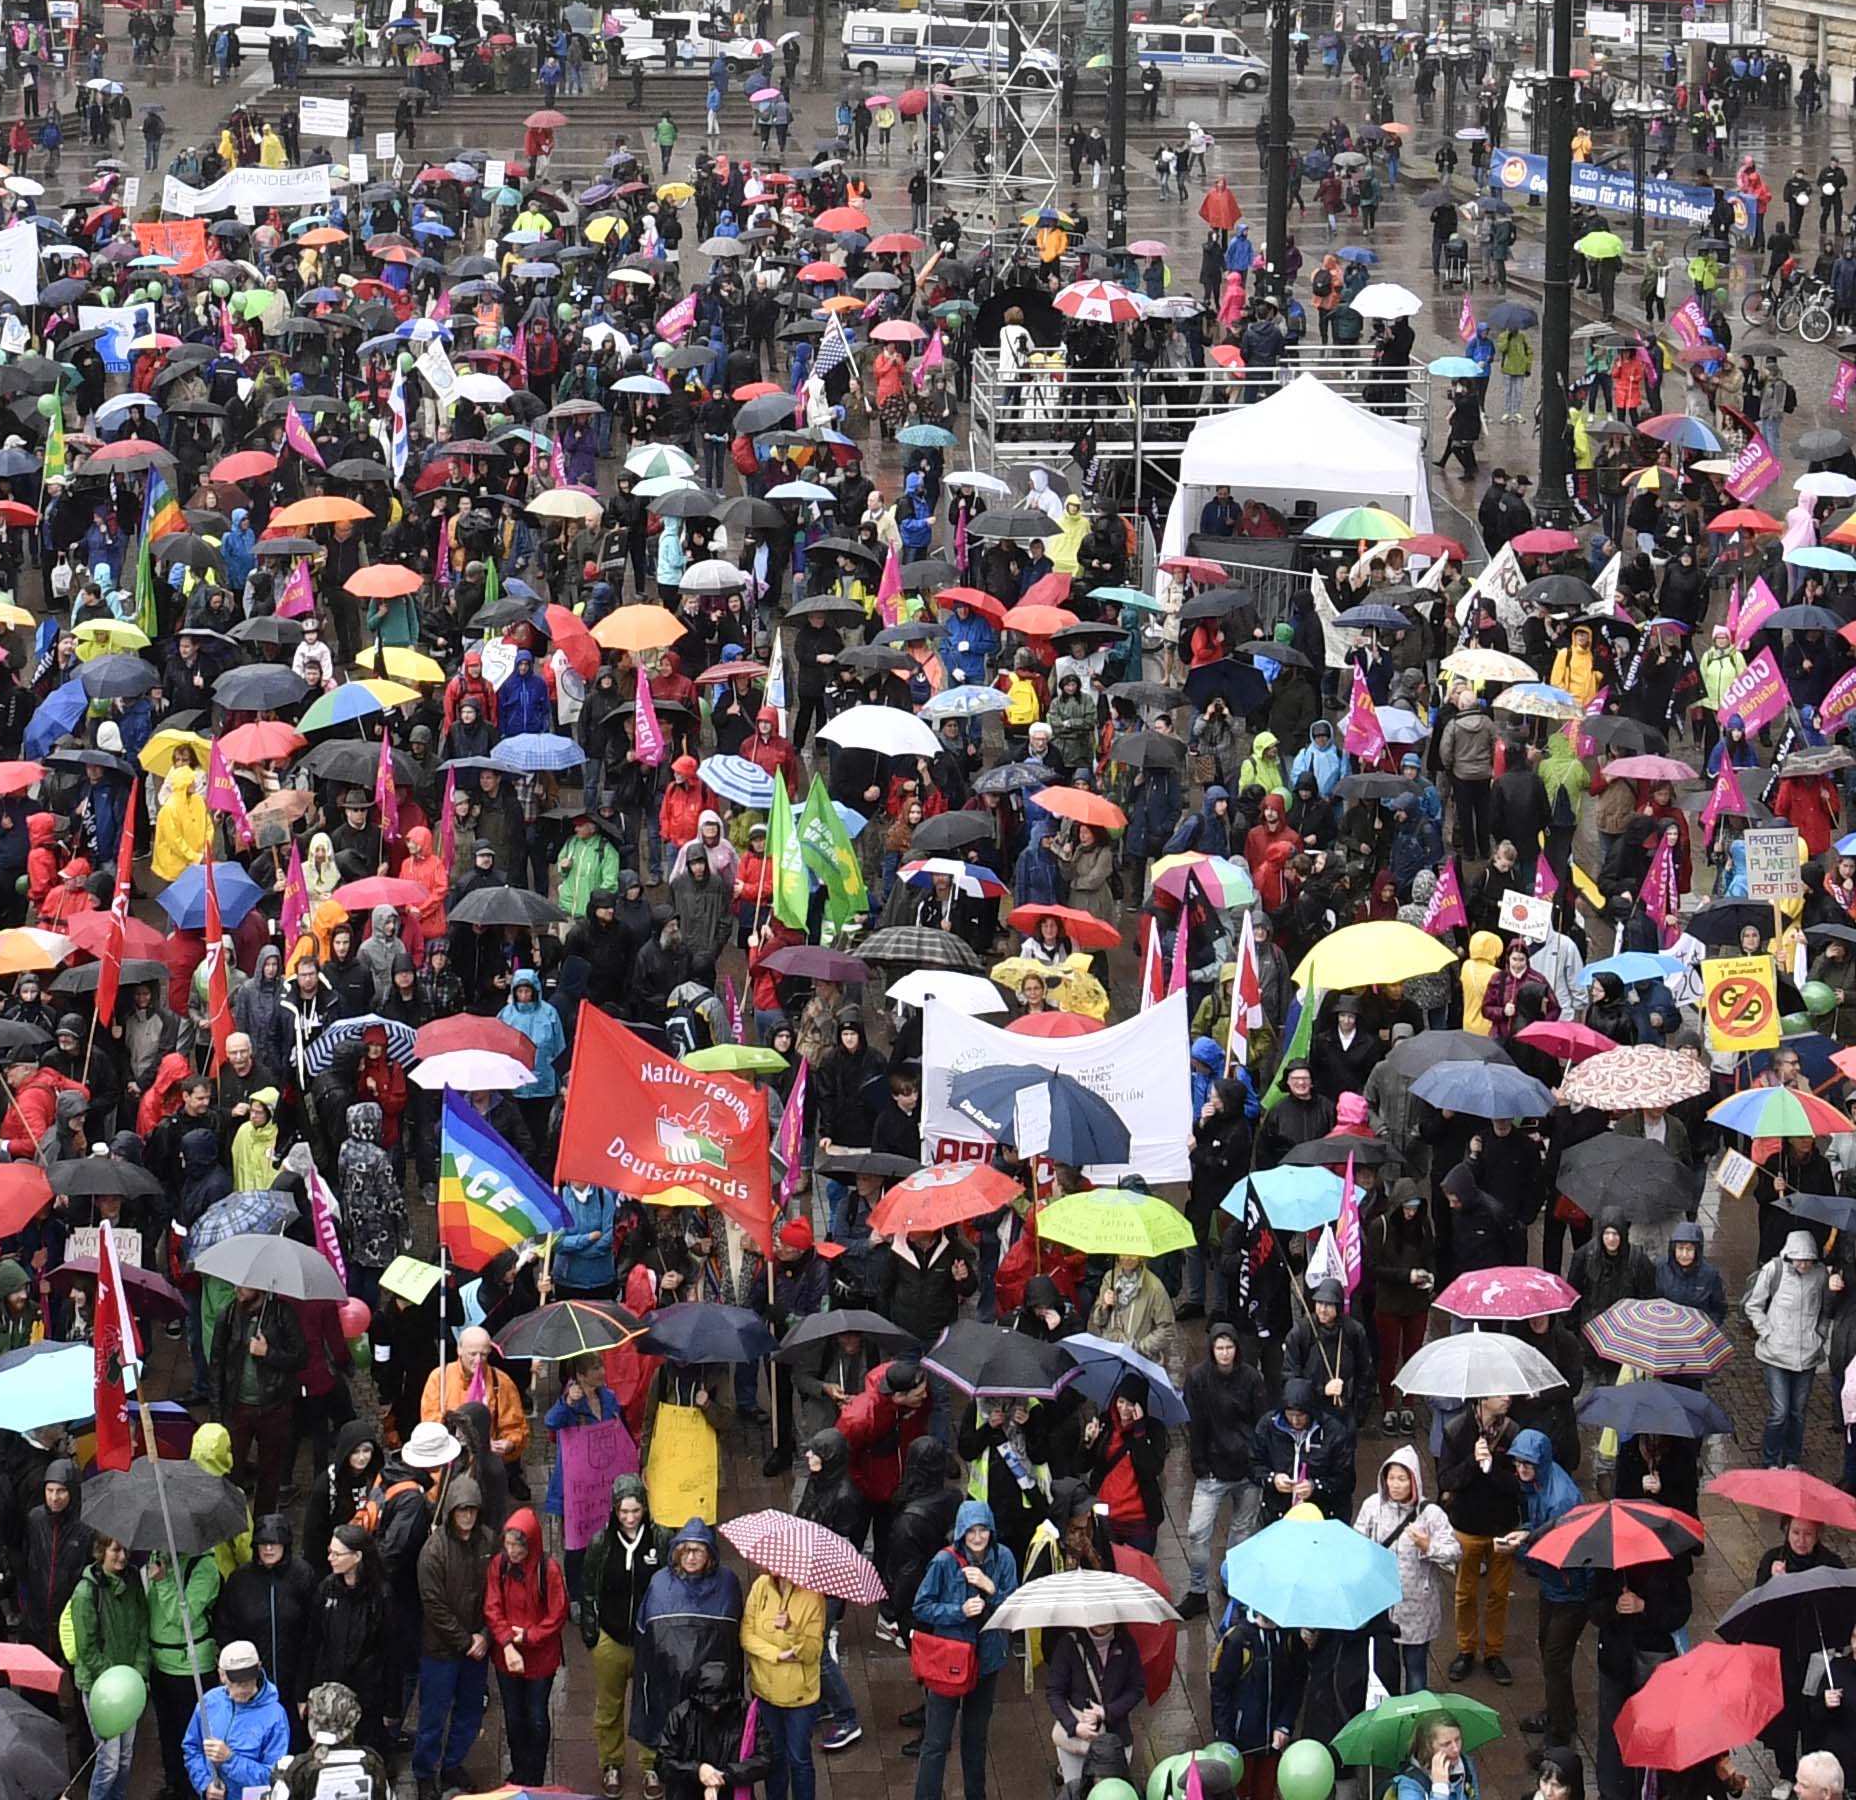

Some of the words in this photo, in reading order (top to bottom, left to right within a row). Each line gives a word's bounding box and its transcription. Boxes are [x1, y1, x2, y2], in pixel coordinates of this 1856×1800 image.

[1578, 168, 1599, 183] G20
[1599, 186, 1617, 204] für
[1748, 833, 1795, 846] PROTECT
[1763, 846, 1784, 856] THE
[1750, 857, 1796, 871] PLANET
[1763, 872, 1785, 882] NOT
[1751, 882, 1799, 895] PROFITS
